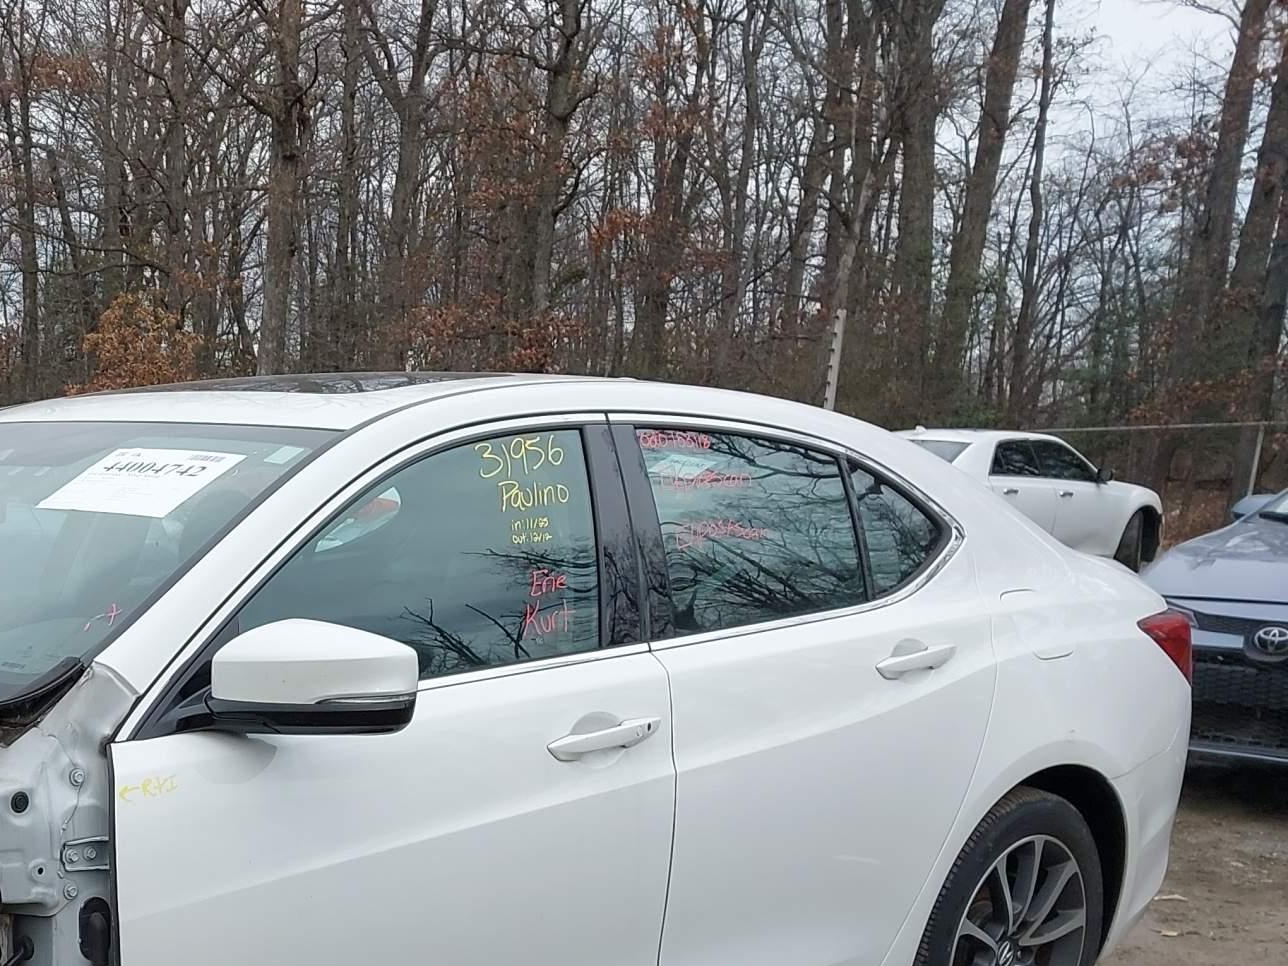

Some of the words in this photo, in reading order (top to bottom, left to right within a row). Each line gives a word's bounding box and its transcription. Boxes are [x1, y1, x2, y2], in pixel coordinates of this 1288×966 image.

[103, 461, 208, 477] 44004742
[474, 434, 564, 479] 31956
[498, 480, 569, 513] Paulino
[522, 599, 577, 639] Kurt
